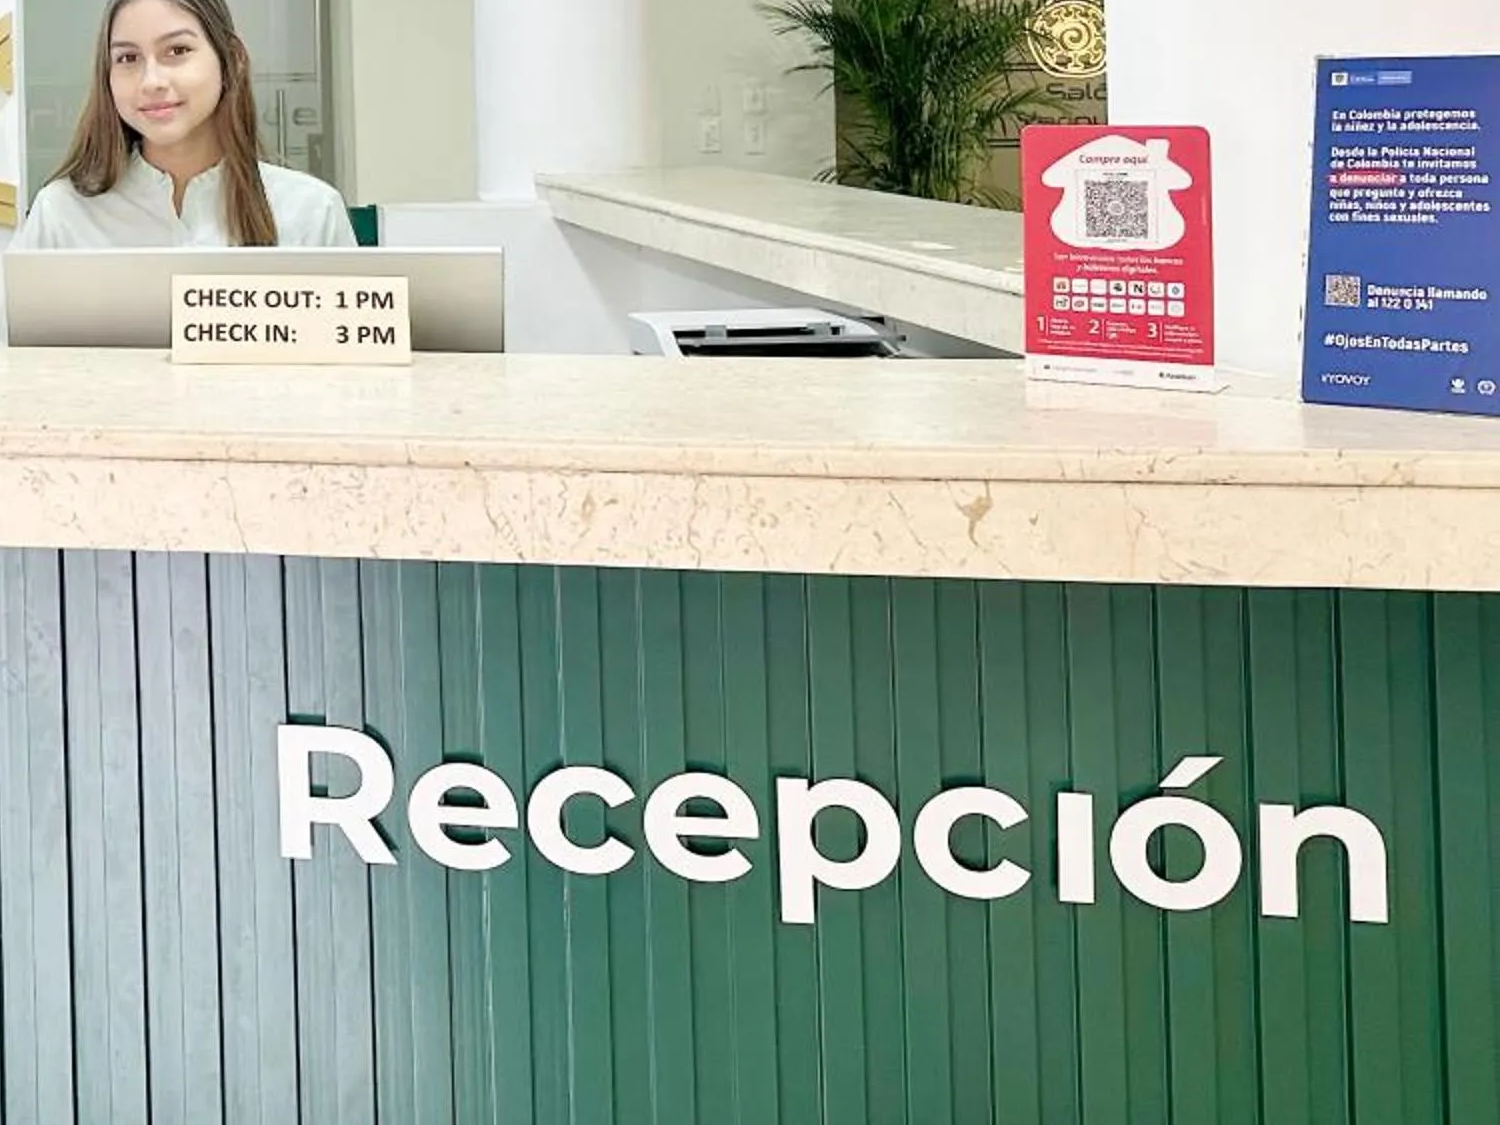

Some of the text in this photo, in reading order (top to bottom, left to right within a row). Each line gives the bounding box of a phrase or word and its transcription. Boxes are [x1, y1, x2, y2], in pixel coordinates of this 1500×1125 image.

[1332, 109, 1476, 121] En Colombia protegemos
[1377, 123, 1385, 133] y
[1387, 121, 1398, 131] la
[1331, 146, 1365, 157] Desde
[1367, 147, 1378, 156] la
[1423, 146, 1475, 157] Nacional
[1330, 158, 1477, 169] de Colombia te invitamos
[1340, 173, 1397, 184] denunciar
[1409, 173, 1436, 184] toda
[1439, 174, 1489, 185] persona
[1329, 189, 1350, 199] que
[1408, 189, 1415, 199] y
[1399, 201, 1407, 211] y
[1409, 200, 1491, 212] adolescentes
[1329, 211, 1349, 222] con
[1352, 211, 1381, 222] fines
[1367, 284, 1488, 300] Denuncia llamando
[183, 288, 394, 310] CHECK OUT: 1 PM
[1367, 298, 1378, 308] al
[1036, 316, 1045, 332] 1
[1088, 319, 1100, 334] 2
[1147, 323, 1158, 338] 3
[183, 323, 396, 345] CHECK IN: 3 PM
[1324, 333, 1469, 354] #OjosEnTodasPartes
[277, 722, 1389, 925] Recepción
